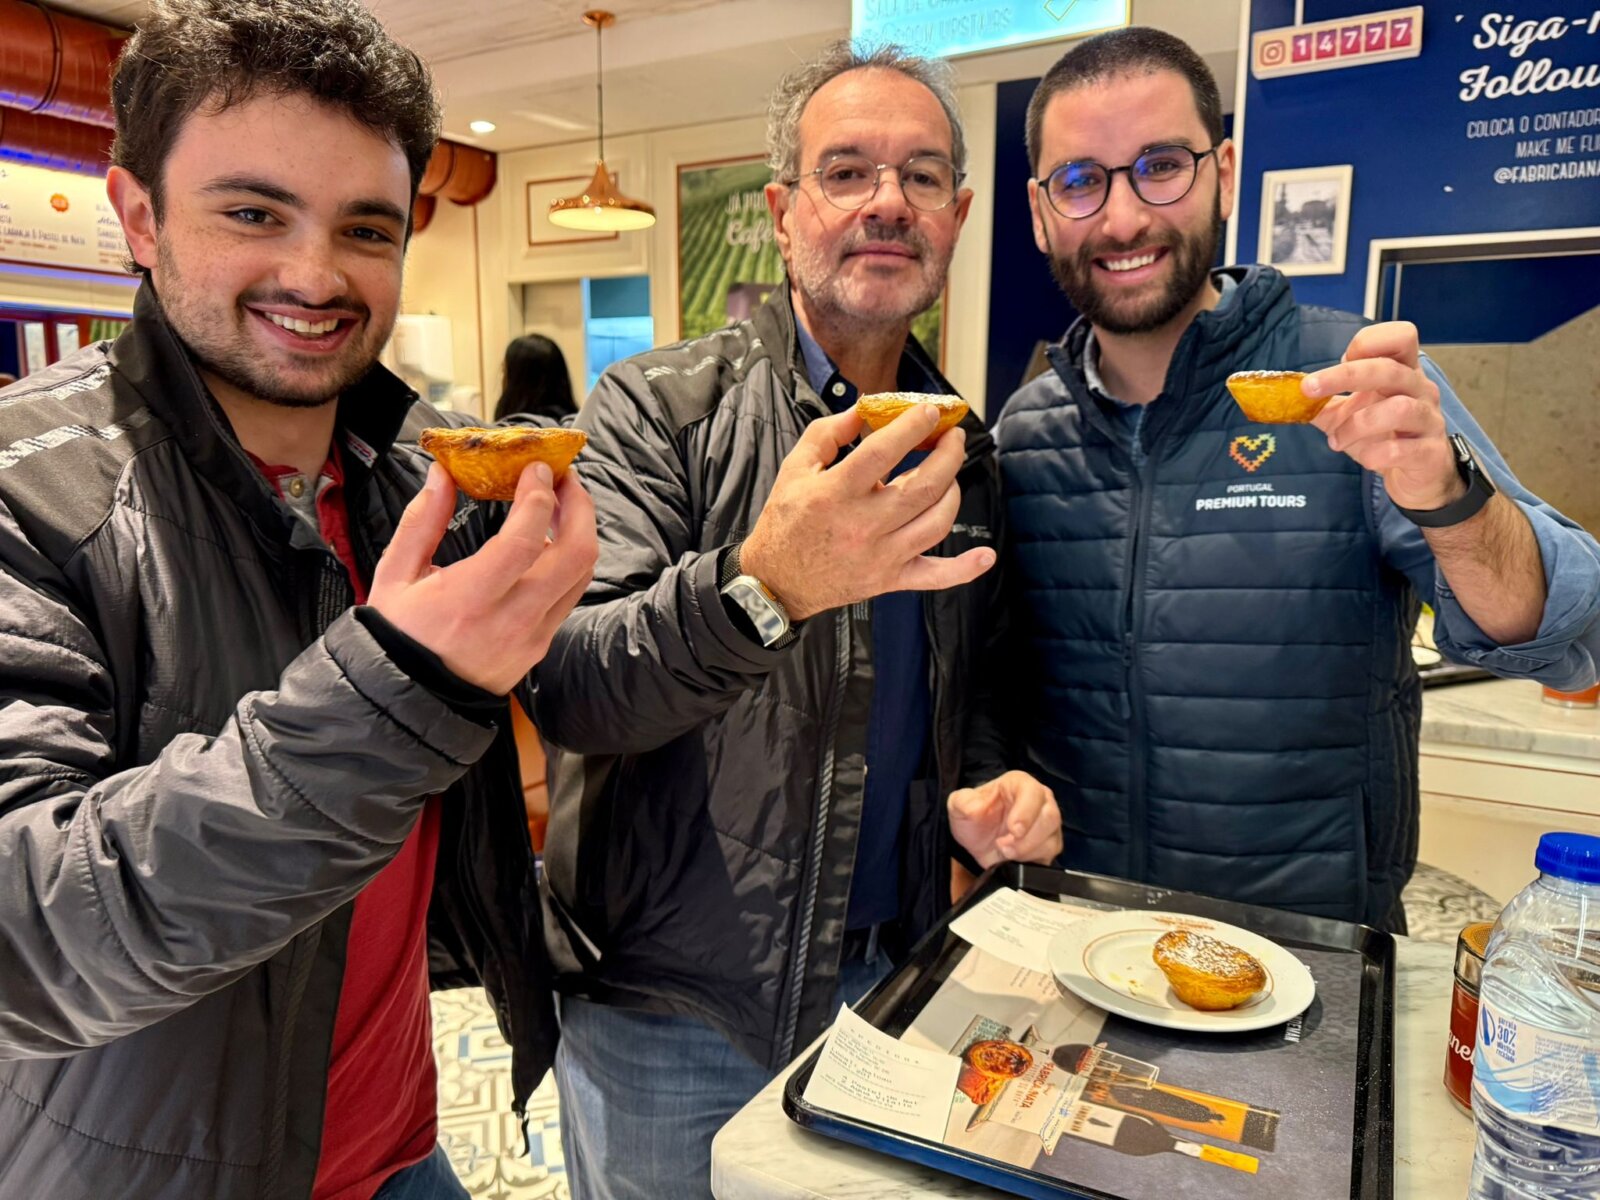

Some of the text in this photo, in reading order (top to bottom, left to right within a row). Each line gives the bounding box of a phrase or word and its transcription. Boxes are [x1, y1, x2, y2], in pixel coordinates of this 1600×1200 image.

[1297, 22, 1409, 57] 14777
[1467, 117, 1515, 139] COLOCA
[1519, 116, 1529, 133] O
[1515, 138, 1551, 158] MAKE
[1555, 136, 1576, 154] ME
[1226, 483, 1274, 493] PORTUGAL
[1196, 495, 1307, 511] PREMIUM TOURS
[1497, 1025, 1516, 1048] 30%
